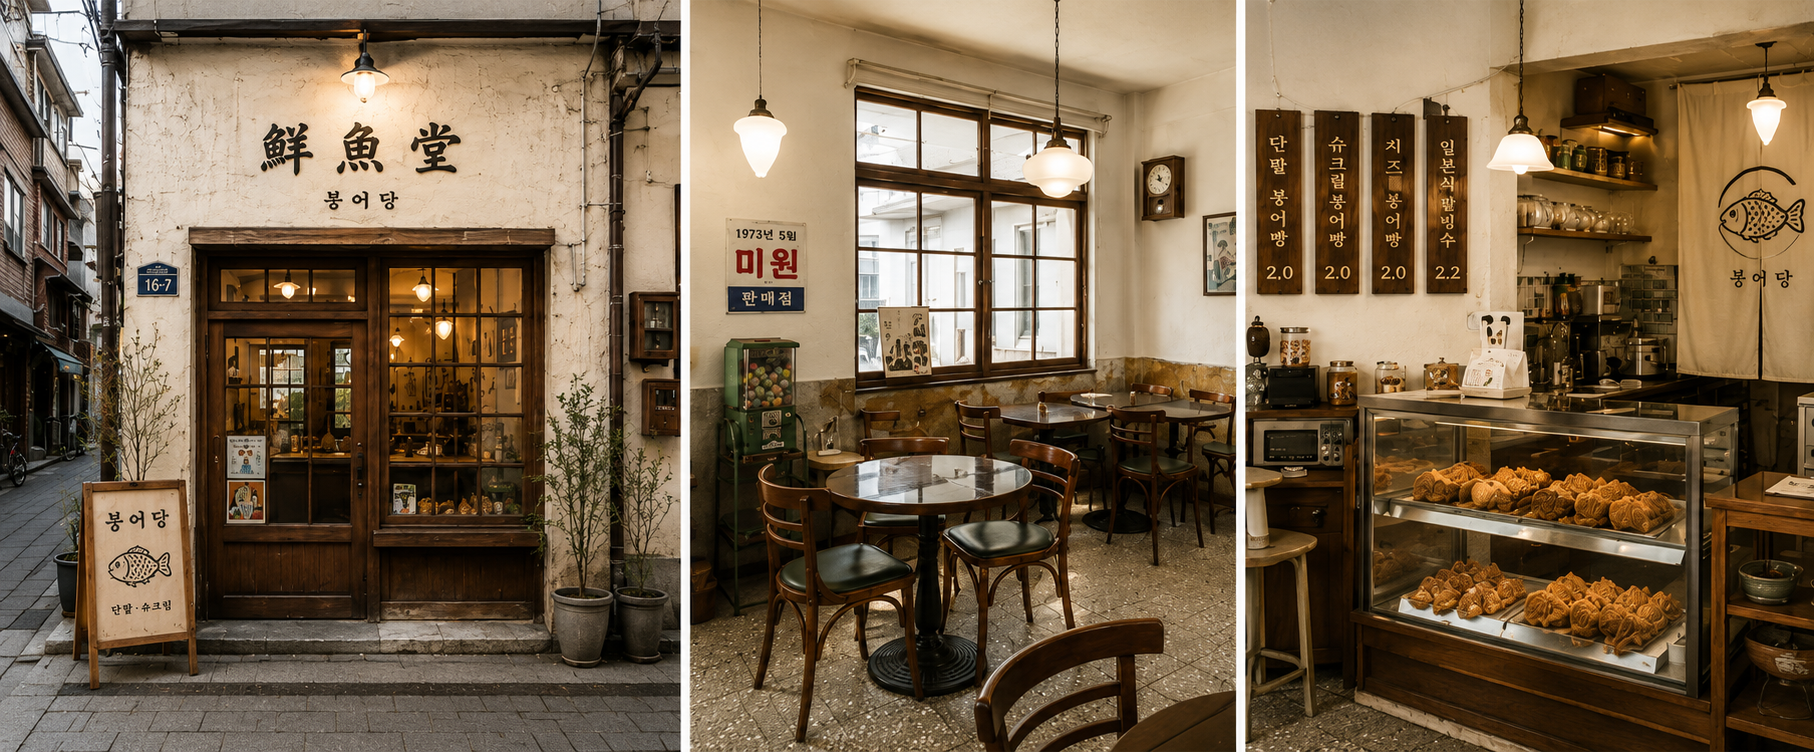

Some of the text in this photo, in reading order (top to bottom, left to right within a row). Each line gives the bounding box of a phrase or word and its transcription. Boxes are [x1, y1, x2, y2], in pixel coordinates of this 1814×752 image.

[261, 122, 461, 177] 鮮魚堂
[1385, 138, 1403, 175] 치즈
[736, 228, 774, 241] 1973년
[735, 247, 799, 280] 미원
[1324, 265, 1351, 280] 2.0
[1381, 265, 1406, 280] 2.0
[1435, 265, 1461, 280] 2.2
[145, 278, 172, 292] 16-7
[741, 290, 792, 307] 판매점
